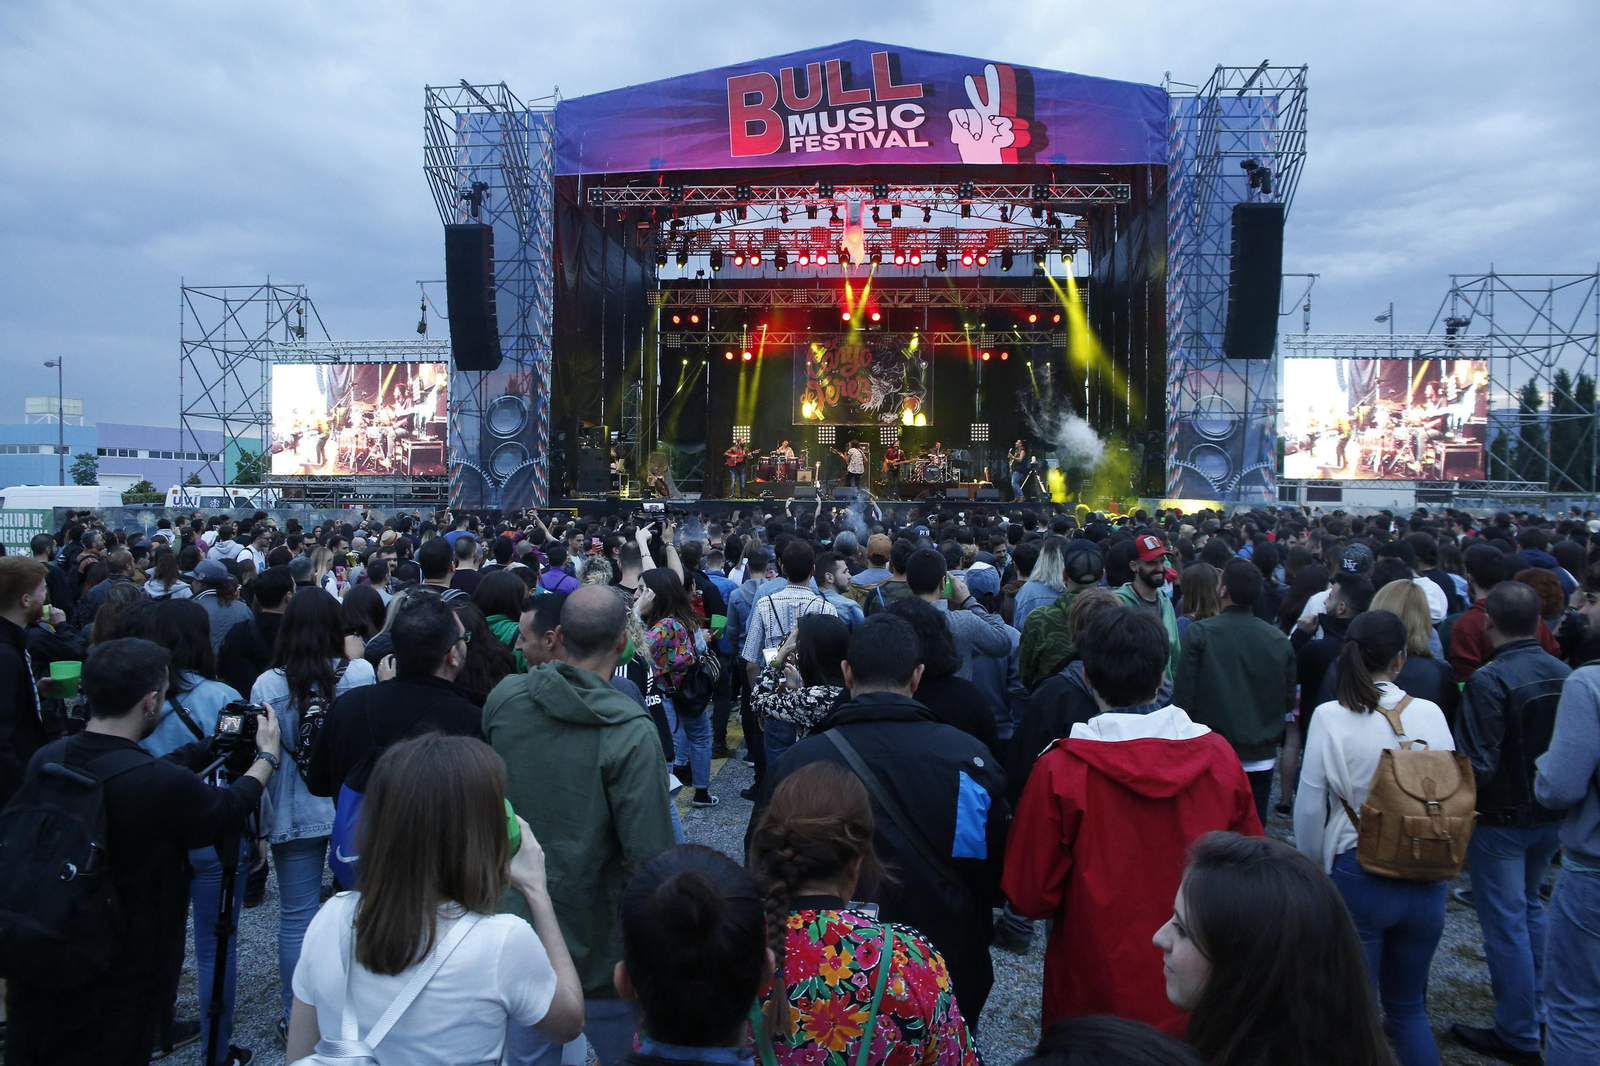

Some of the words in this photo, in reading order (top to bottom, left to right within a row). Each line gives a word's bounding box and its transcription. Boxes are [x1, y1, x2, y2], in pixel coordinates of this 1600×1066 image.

[727, 51, 923, 157] BULL
[787, 103, 926, 136] MUSIC
[789, 129, 929, 153] FESTIVAL
[32, 513, 43, 528] DE
[1344, 558, 1358, 571] NY
